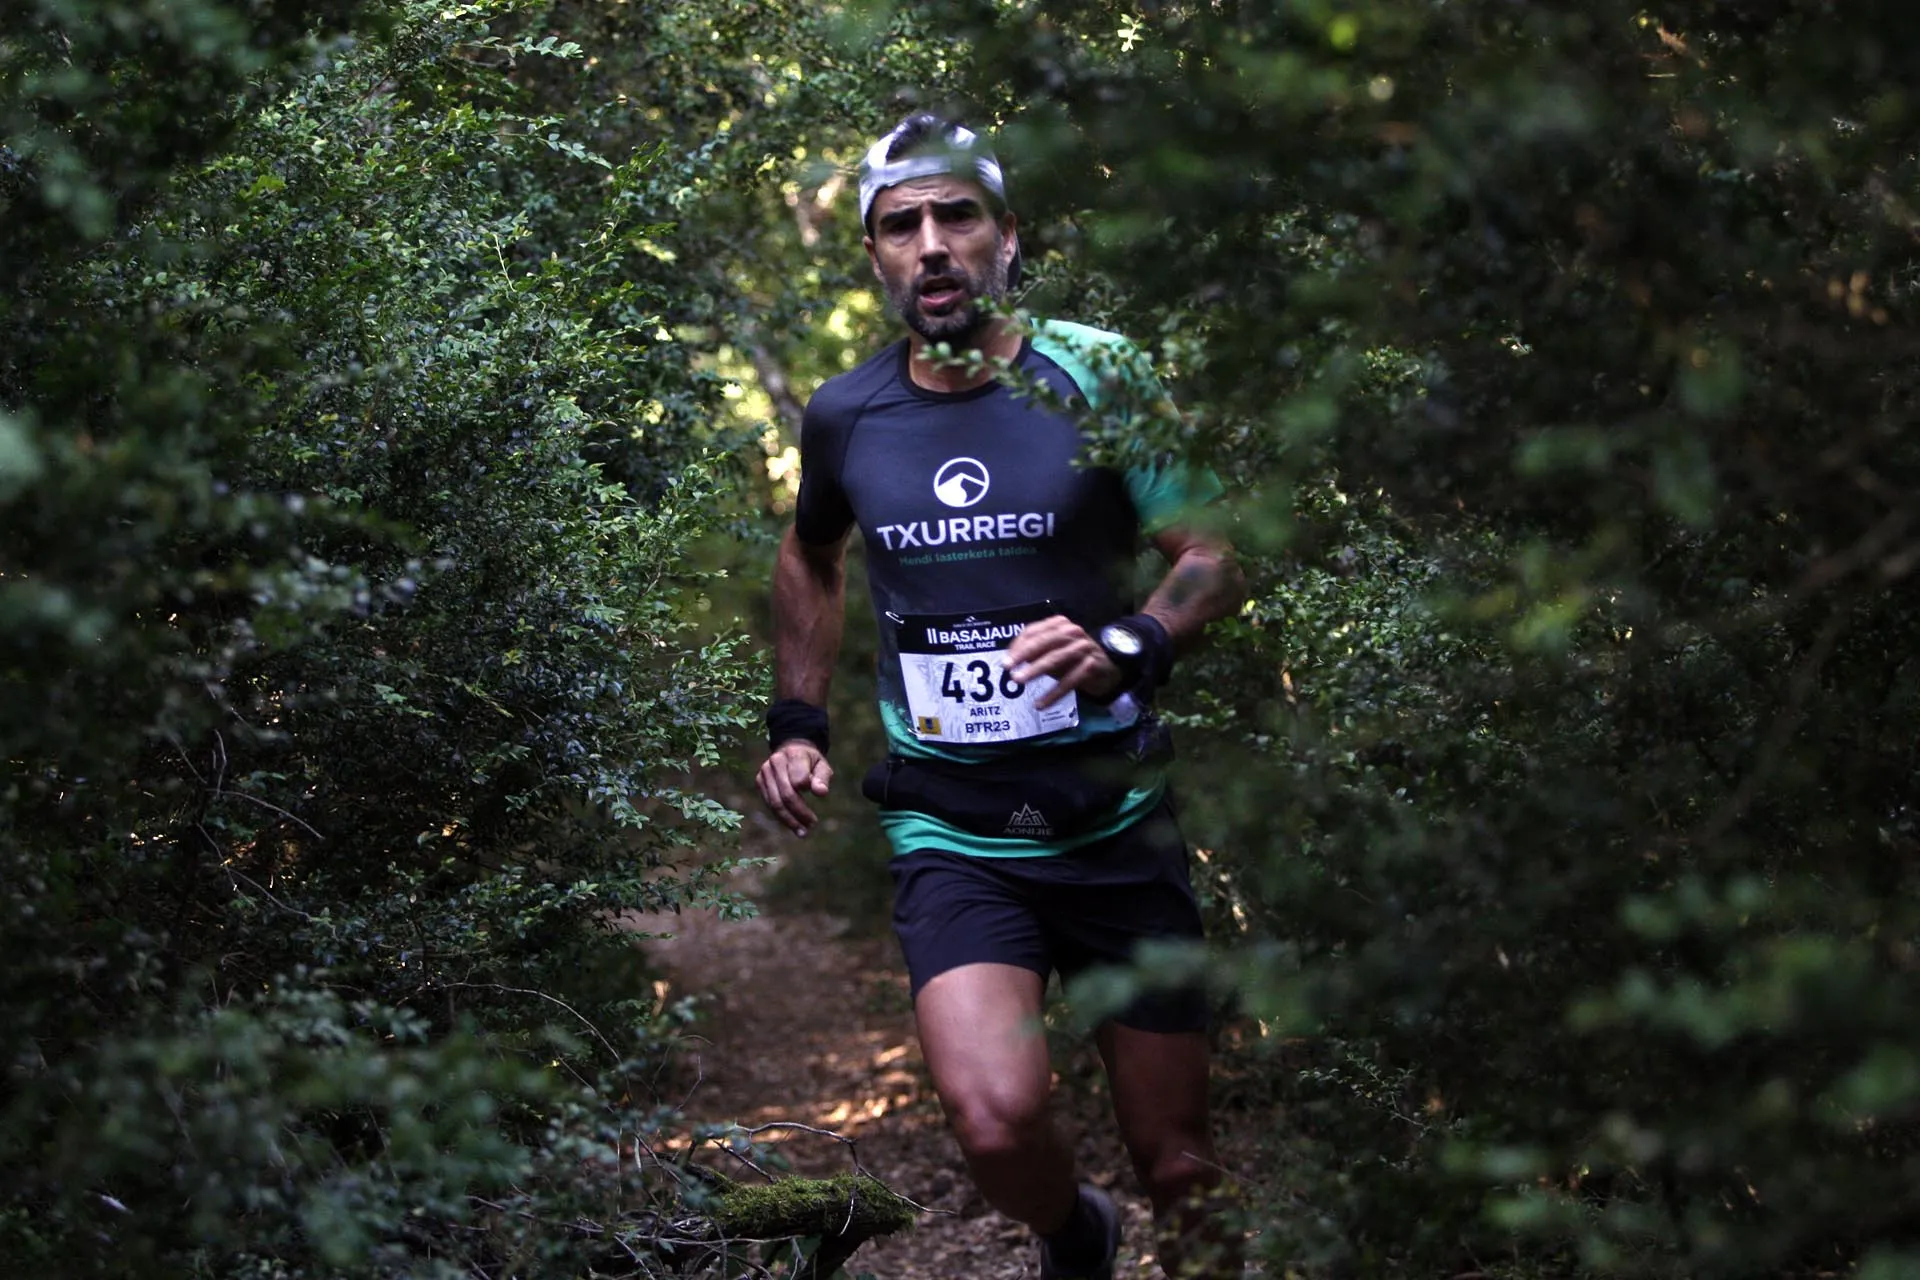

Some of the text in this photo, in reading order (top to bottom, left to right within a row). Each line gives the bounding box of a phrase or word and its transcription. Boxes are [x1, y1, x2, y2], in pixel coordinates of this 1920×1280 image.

[877, 513, 1054, 550] TXURREGI
[899, 554, 933, 566] Mendi
[936, 549, 995, 562] lasterketa
[939, 623, 1025, 643] BASAJAUN
[955, 641, 996, 651] TRAIL RACE
[942, 660, 1025, 703] 436
[970, 706, 1001, 717] ARITZ
[965, 720, 1010, 734] BTR23
